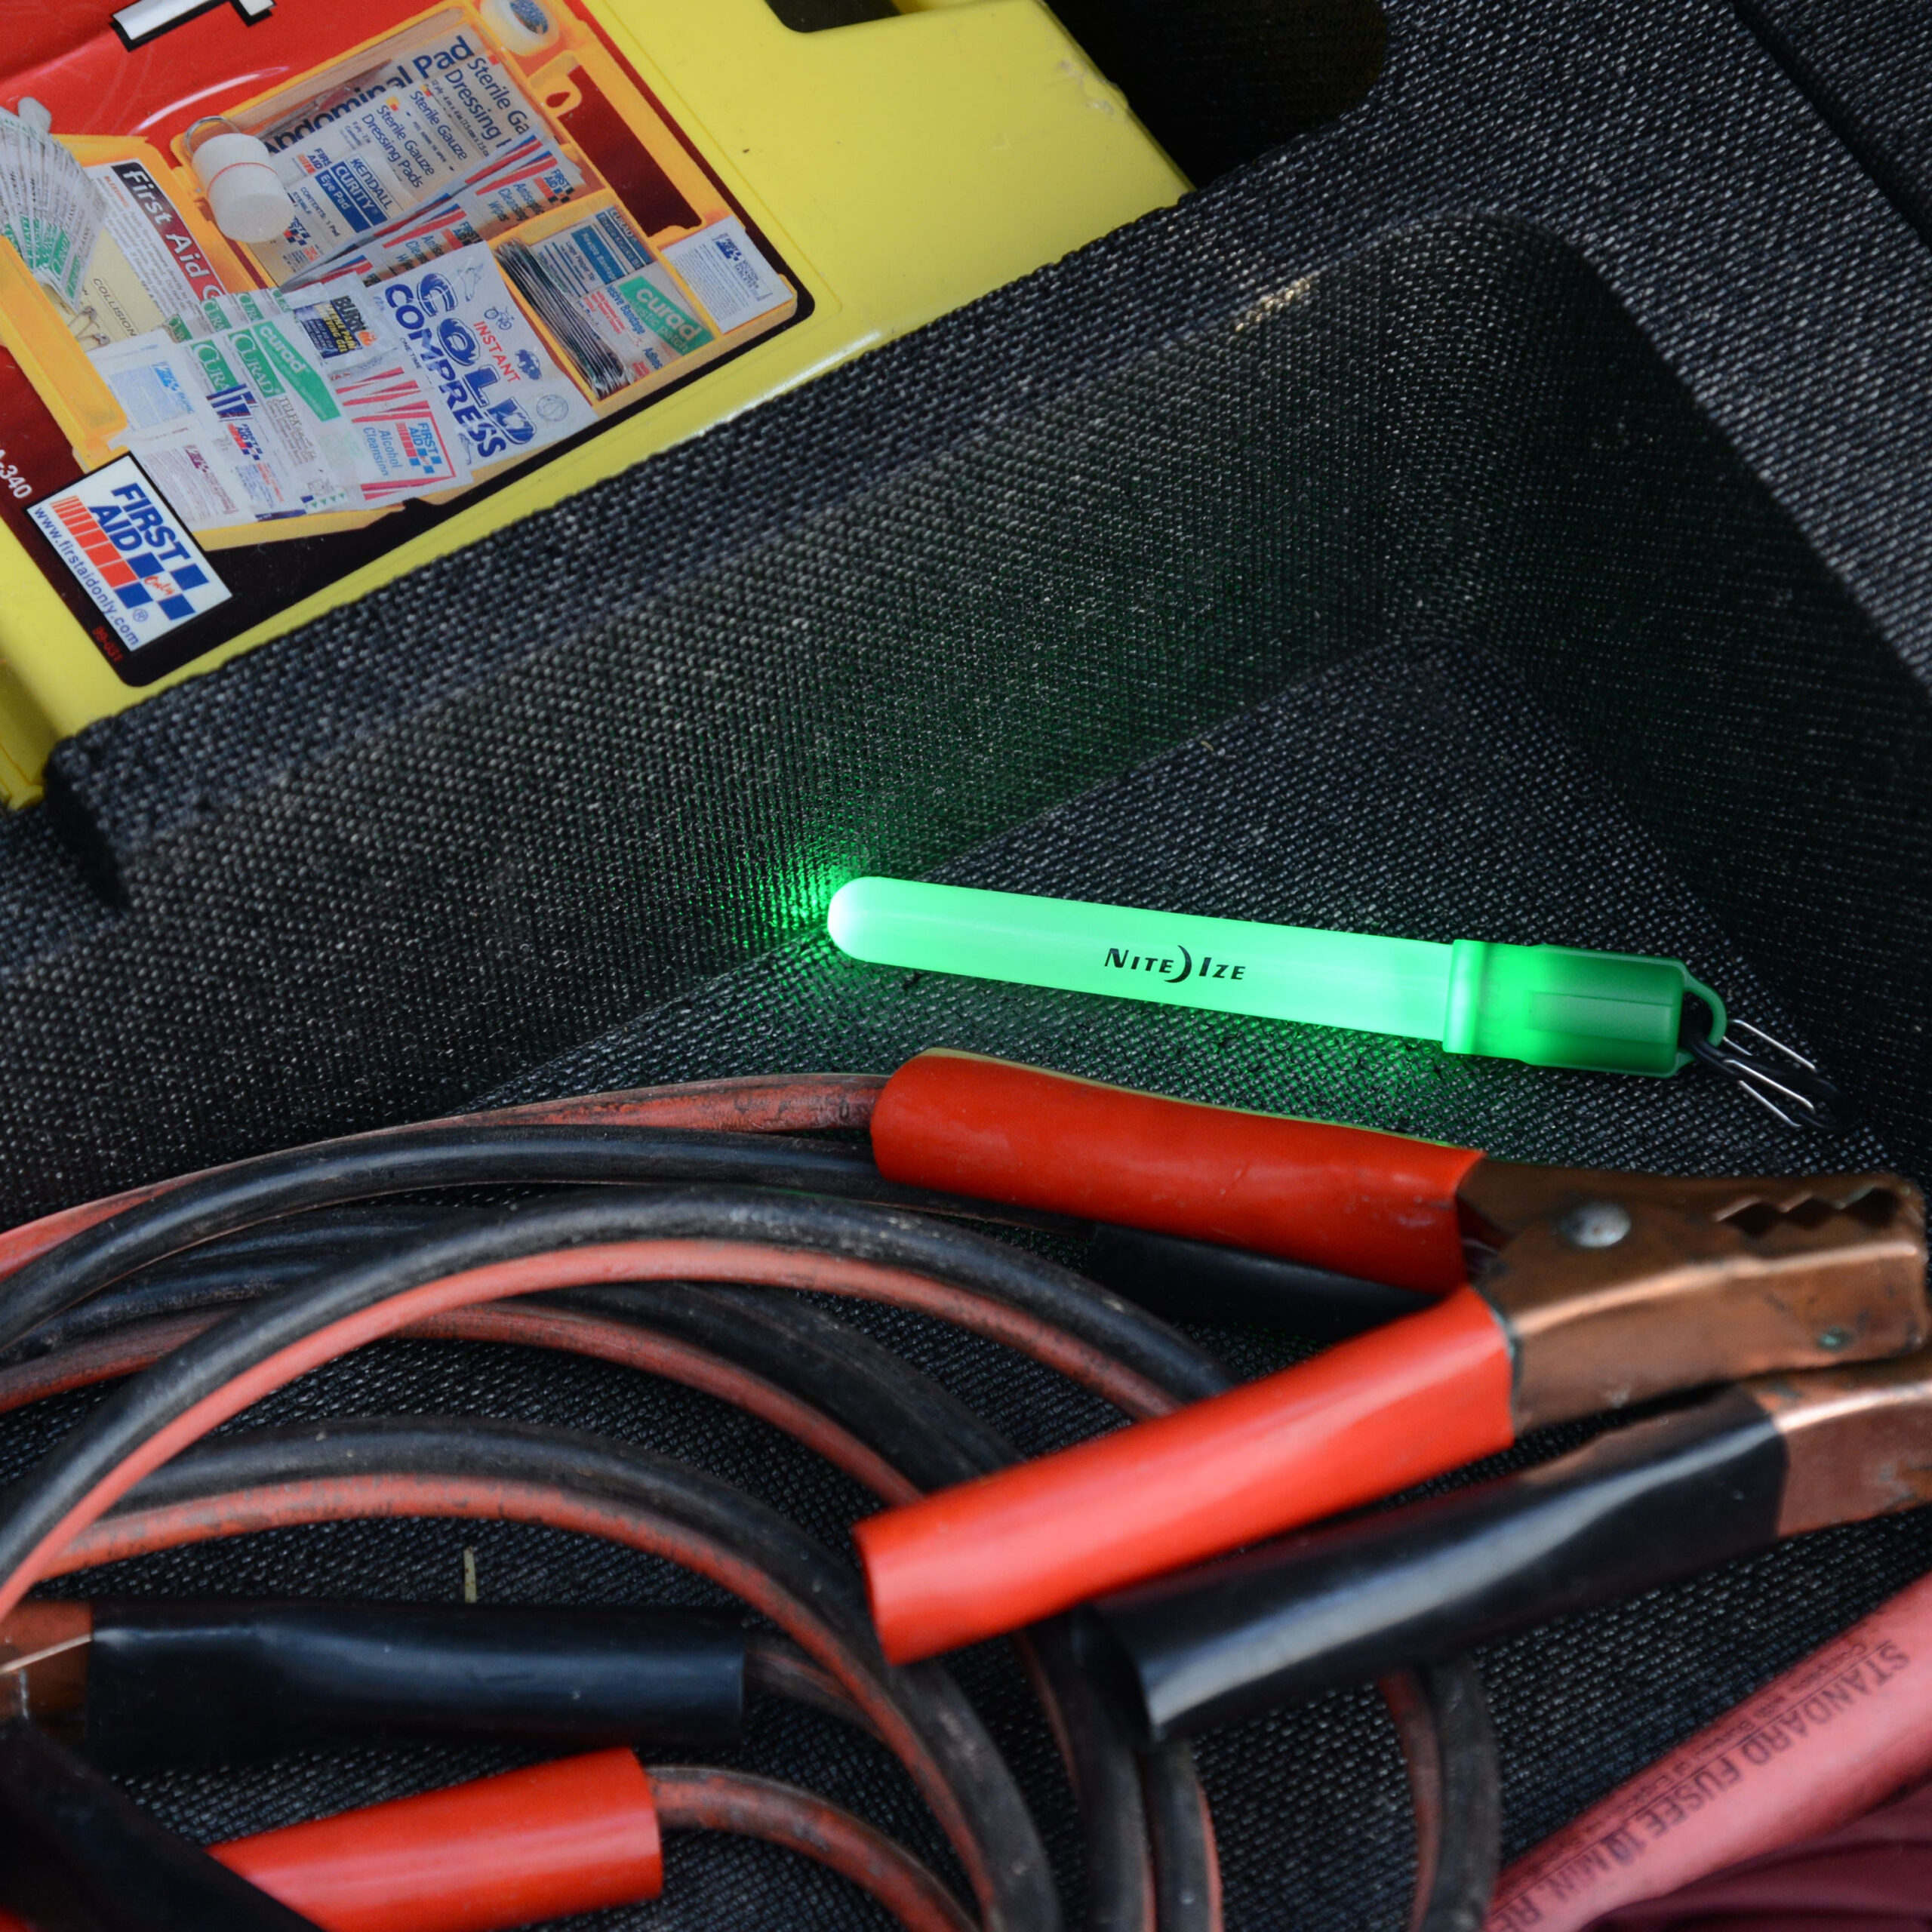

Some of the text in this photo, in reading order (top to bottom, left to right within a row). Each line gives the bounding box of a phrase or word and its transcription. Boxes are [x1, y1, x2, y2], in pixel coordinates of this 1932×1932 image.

[412, 35, 475, 80] Pad
[445, 69, 501, 141] Dressing
[467, 57, 509, 109] Sterile
[377, 106, 435, 175] Sterile Gauze
[410, 91, 467, 160] Sterile Gauze
[306, 154, 323, 170] AID
[361, 114, 423, 187] Dressing Pads
[320, 174, 351, 210] Eye Pad
[334, 165, 374, 210] CURITY
[350, 158, 391, 208] KENDALL
[543, 176, 558, 188] AID
[552, 169, 570, 188] FIRST
[123, 171, 173, 225] First
[165, 236, 209, 278] Aid
[300, 186, 325, 218] CONTENTS:
[329, 224, 340, 237] Pad
[488, 201, 509, 220] Wipes
[498, 188, 528, 224] Cleansing
[734, 266, 752, 287] TABLETS
[739, 263, 758, 288] SICKNESS
[93, 278, 137, 336] COLLISION
[333, 296, 367, 332] BURN
[620, 305, 645, 334] Bandage
[638, 288, 701, 340] curad
[260, 325, 306, 373] curad
[335, 338, 349, 352] GEL
[399, 337, 422, 369] ONE TIME
[415, 275, 531, 445] COLD
[474, 320, 519, 381] INSTANT
[658, 326, 690, 353] patch
[195, 344, 229, 389] CURA
[232, 333, 300, 425] CURAD TELFA
[383, 286, 506, 458] COMPRESS
[235, 428, 248, 440] AID
[242, 423, 258, 445] FIRST
[379, 432, 402, 466] Alcohol
[408, 427, 423, 446] AID
[419, 423, 437, 452] FIRST
[0, 449, 32, 498] -340
[111, 483, 190, 561] FIRST
[88, 506, 174, 594] AID Only
[35, 509, 138, 645] www.firstaidonly.com
[1740, 1645, 1909, 1764] STANDARD
[1635, 1758, 1743, 1838] FUSEE
[1603, 1826, 1647, 1868] 10
[1539, 1850, 1609, 1903] MIN.
